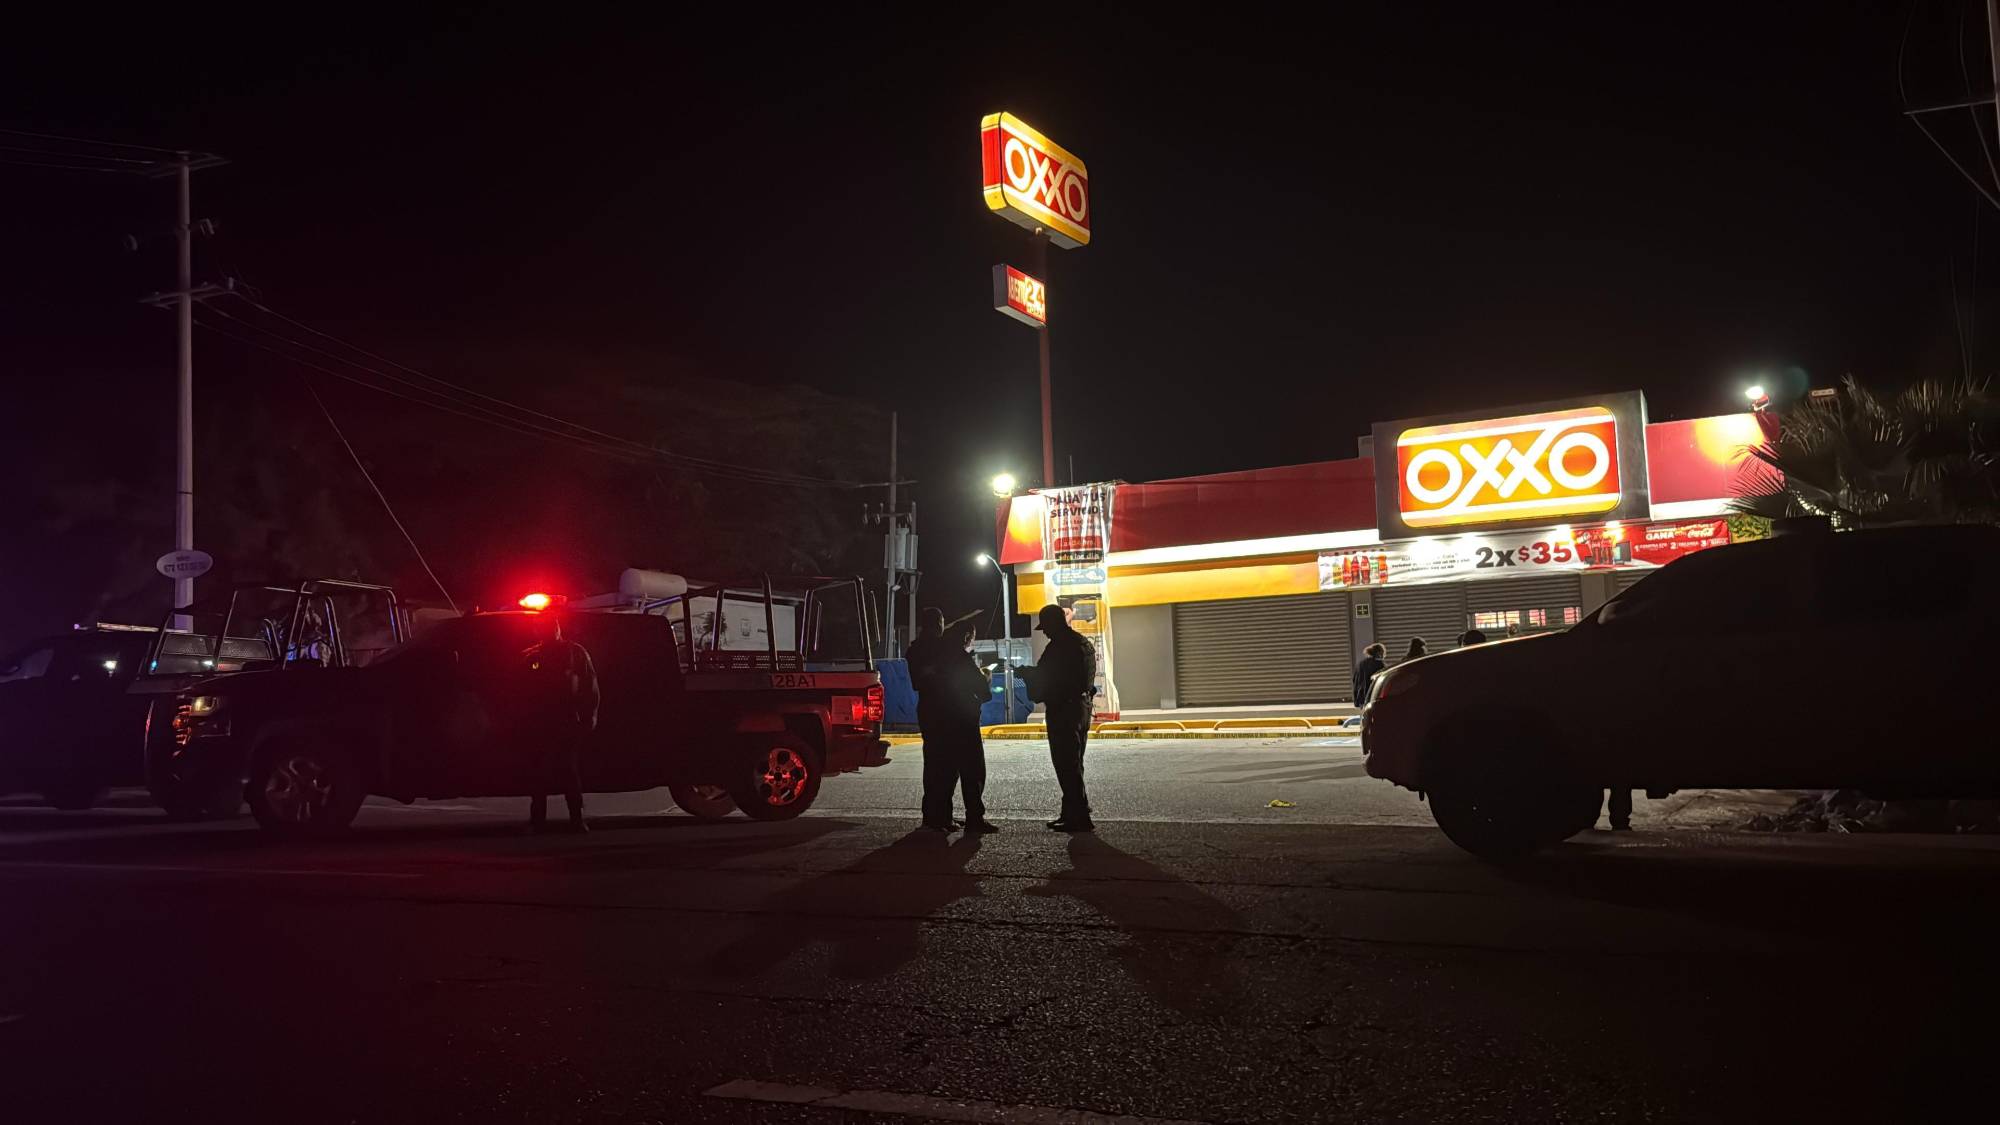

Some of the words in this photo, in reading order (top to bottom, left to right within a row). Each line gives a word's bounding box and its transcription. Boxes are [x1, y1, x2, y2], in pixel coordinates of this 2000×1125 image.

[1005, 138, 1087, 222] OXXO
[1027, 279, 1044, 304] 24
[1406, 434, 1609, 510] OXXO
[1646, 531, 1674, 541] GANA
[1670, 542, 1677, 550] 2
